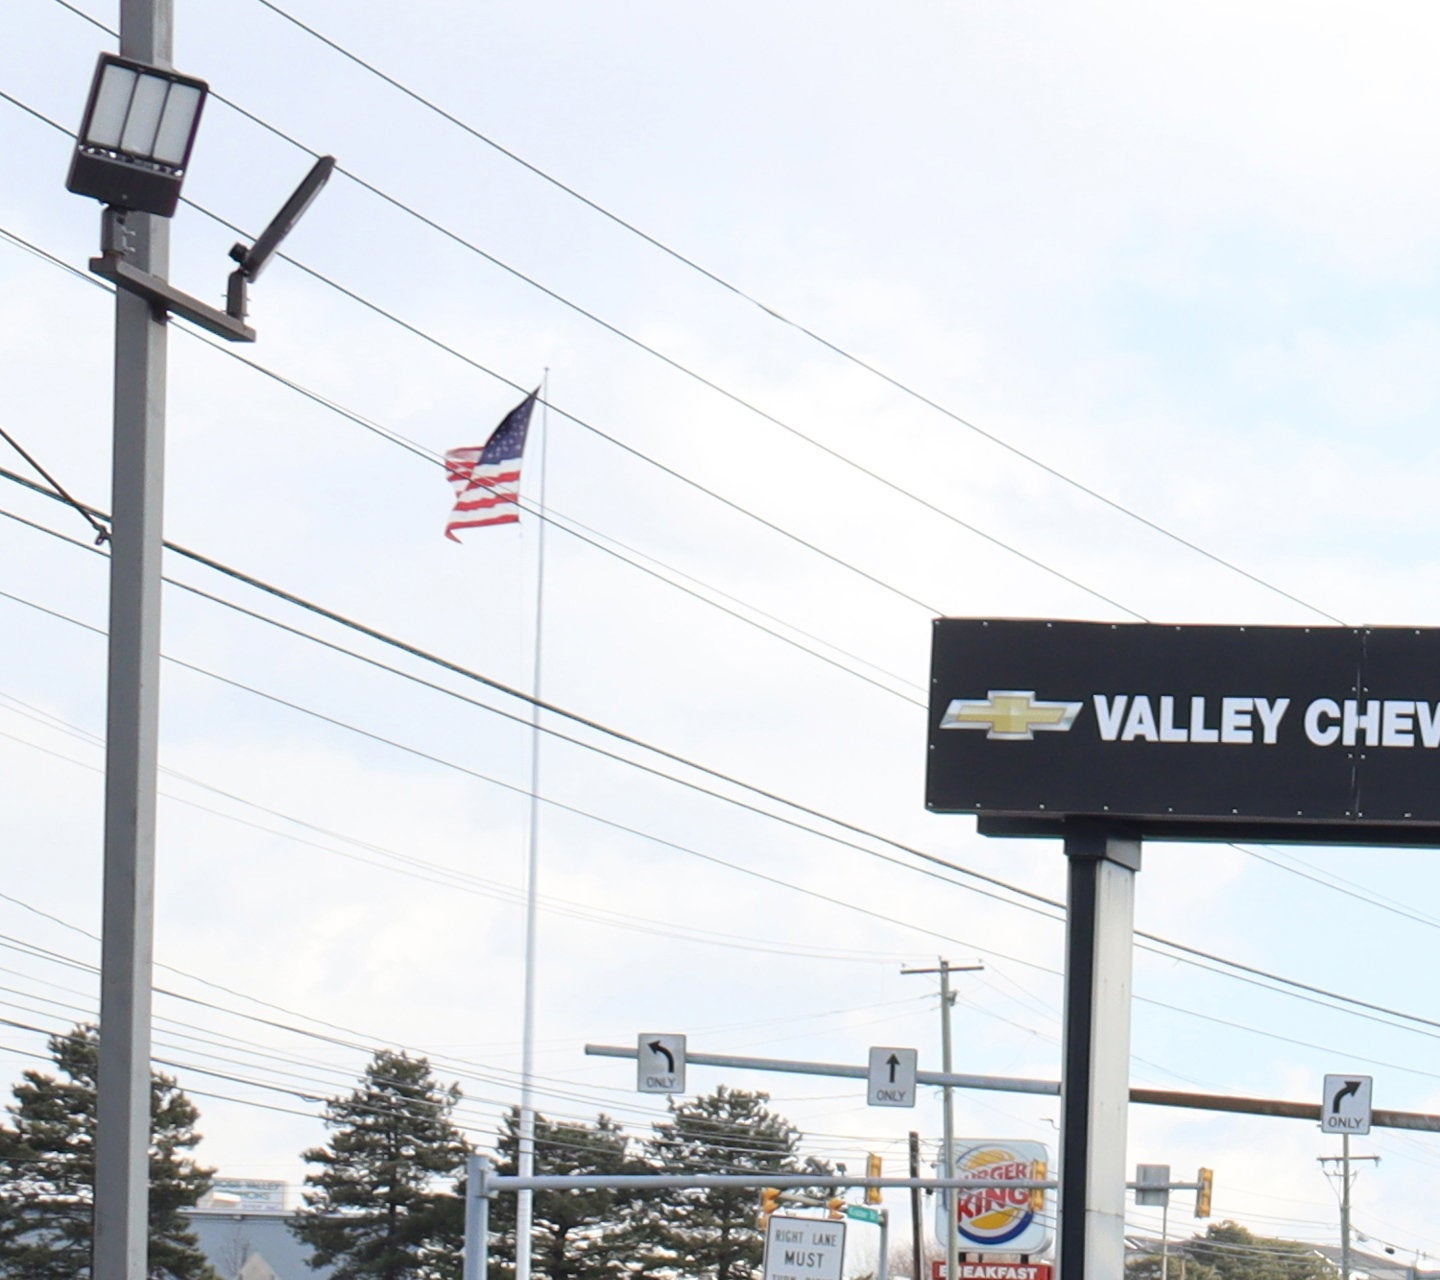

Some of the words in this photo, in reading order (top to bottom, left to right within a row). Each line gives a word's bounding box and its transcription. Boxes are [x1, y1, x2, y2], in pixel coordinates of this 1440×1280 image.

[1092, 693, 1290, 747] VALLEY
[646, 1075, 676, 1088] ONLY
[876, 1089, 906, 1102] ONLY
[1328, 1115, 1363, 1129] ONLY
[957, 1183, 1030, 1222] KING
[775, 1229, 804, 1243] RIGHT
[812, 1232, 838, 1246] LANE
[784, 1250, 824, 1268] MUST
[940, 1264, 1037, 1280] BEAKFAST
